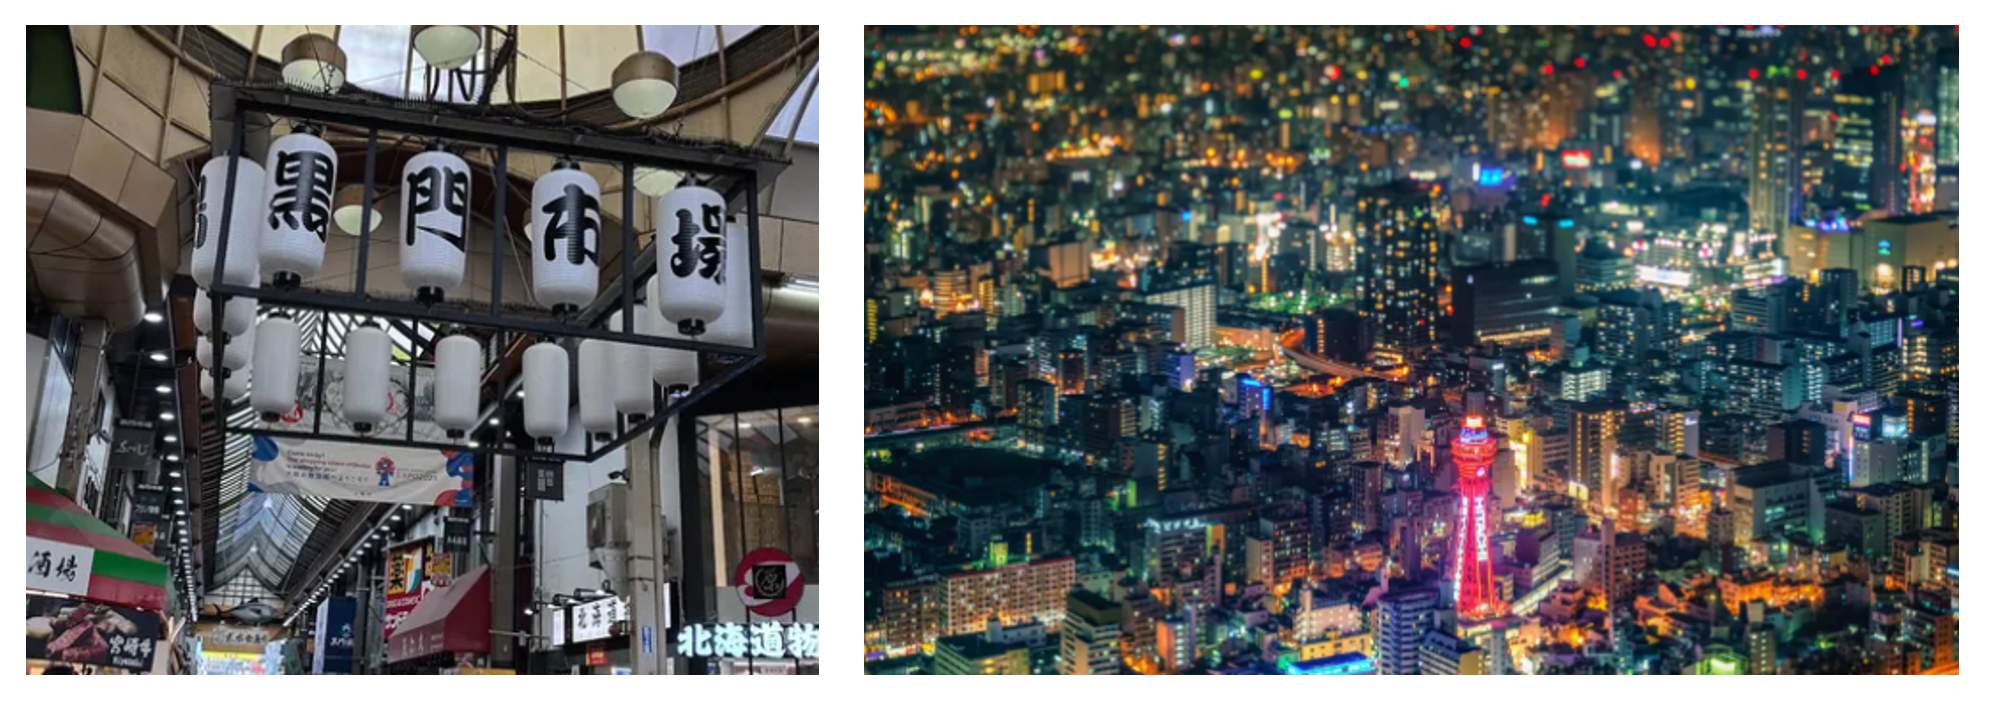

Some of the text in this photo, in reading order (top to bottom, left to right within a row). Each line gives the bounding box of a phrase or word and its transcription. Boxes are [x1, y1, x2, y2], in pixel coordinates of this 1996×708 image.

[268, 150, 334, 244] 黒
[405, 166, 468, 253] 門
[542, 183, 600, 267] 市
